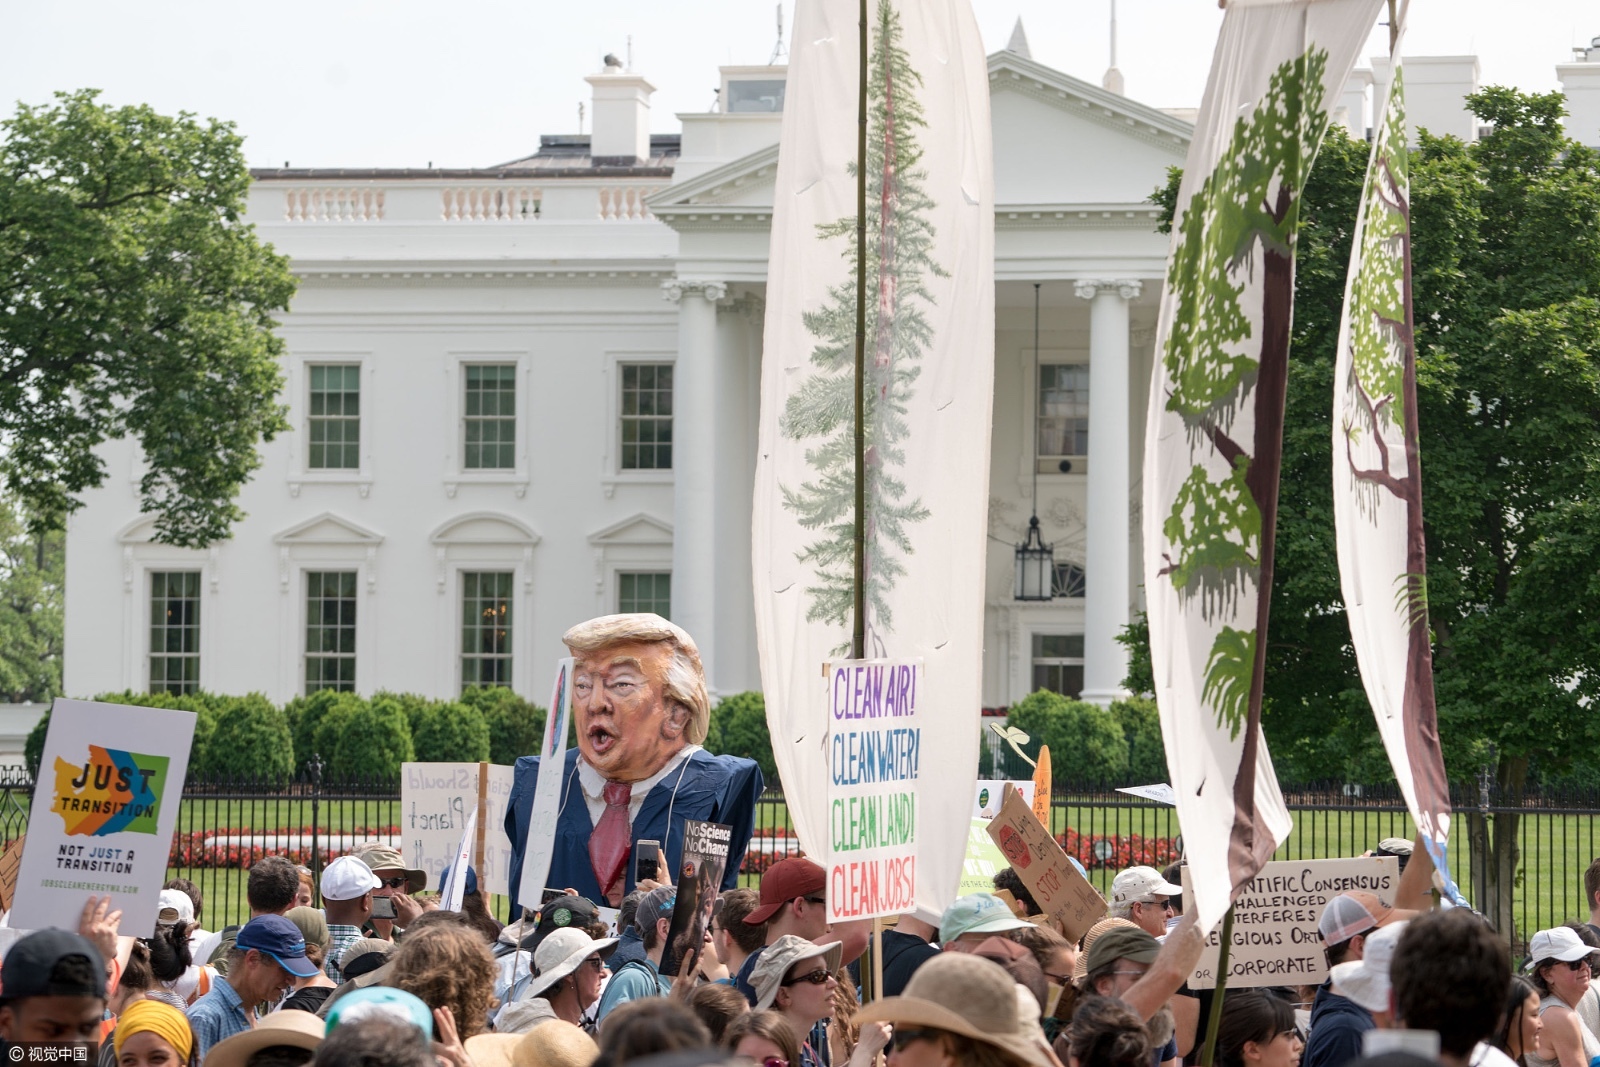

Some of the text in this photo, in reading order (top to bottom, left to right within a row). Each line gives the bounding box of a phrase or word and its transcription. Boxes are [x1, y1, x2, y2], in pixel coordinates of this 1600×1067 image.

[834, 664, 916, 720] CLEAN AIR!
[833, 728, 920, 785] CLEAN WATER!
[71, 763, 156, 794] JUST
[61, 797, 155, 818] TRANSITION
[832, 792, 914, 852] CLEAN LAND!
[58, 844, 135, 861] NOT JUST A
[57, 858, 133, 874] TRANSITION
[832, 855, 915, 917] CLEAN JOBS!
[1037, 867, 1062, 902] STOP
[1243, 876, 1299, 895] NTIFIC
[1234, 895, 1327, 910] HALLENGED
[1233, 909, 1316, 925] TERFERES
